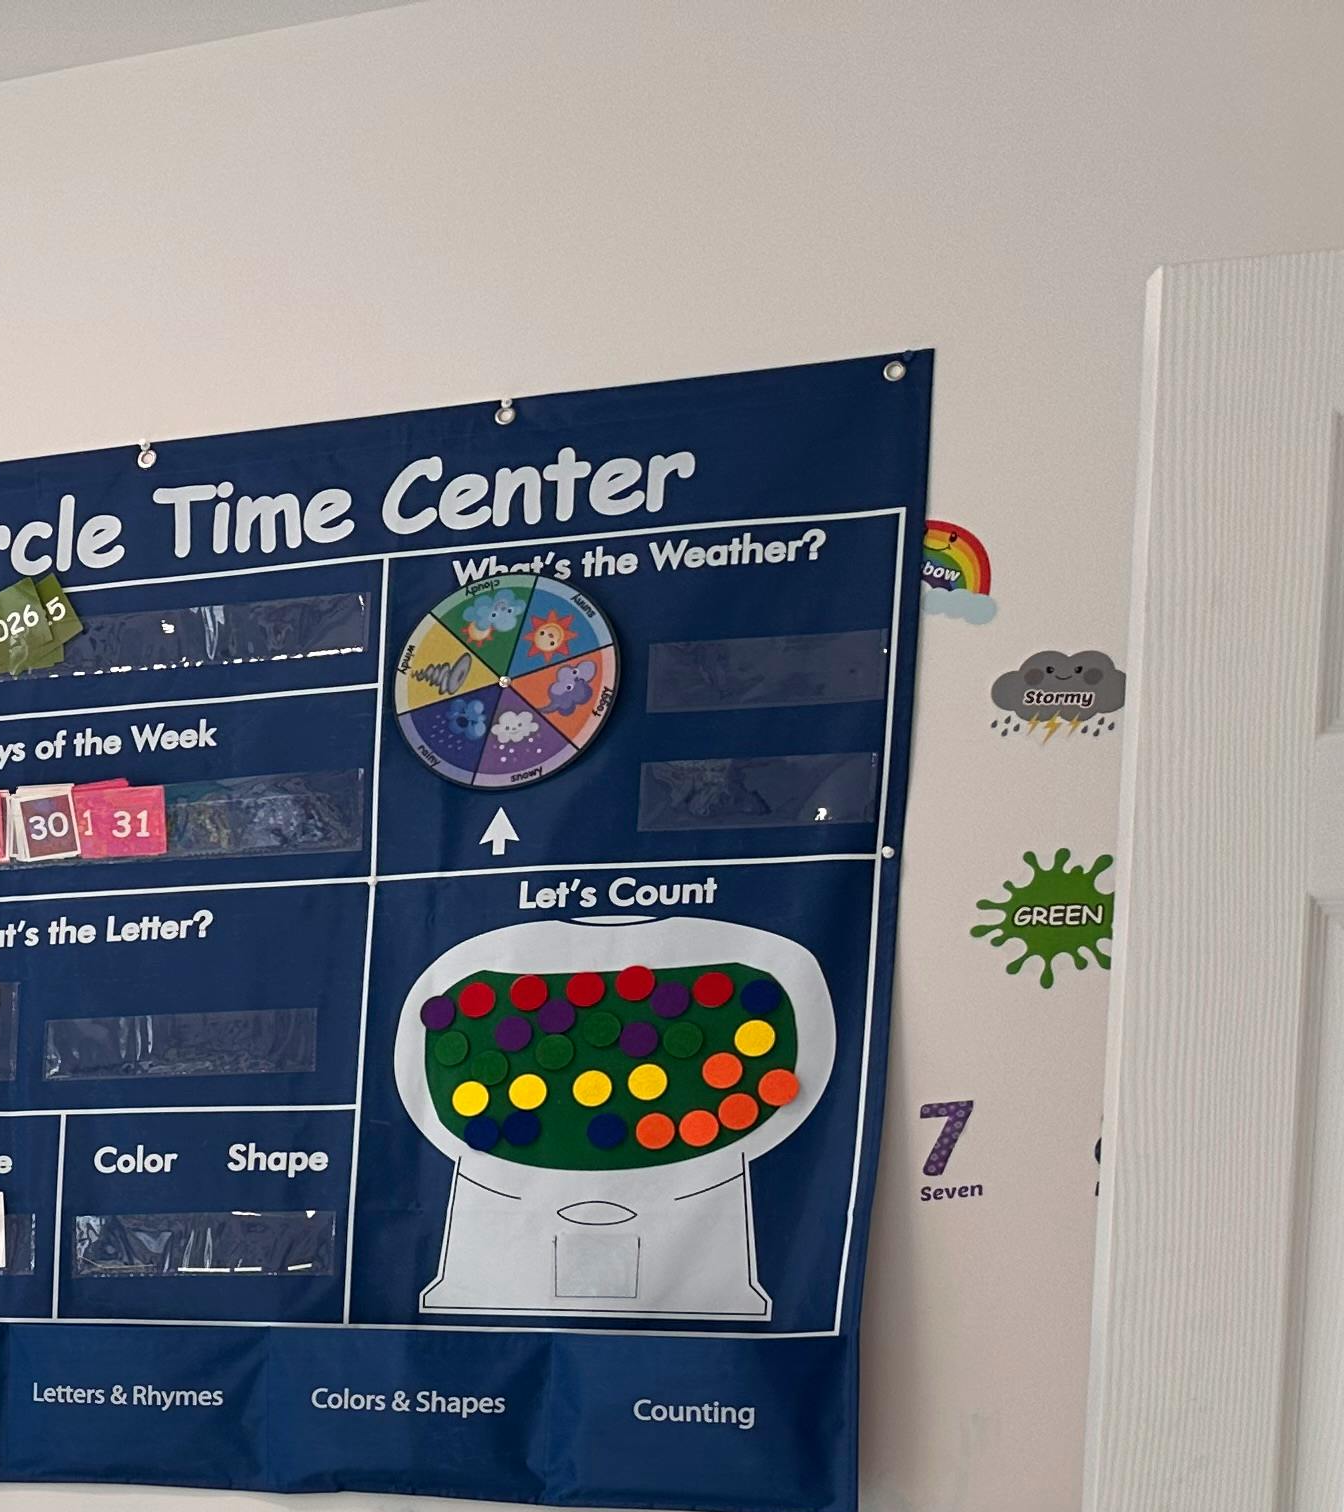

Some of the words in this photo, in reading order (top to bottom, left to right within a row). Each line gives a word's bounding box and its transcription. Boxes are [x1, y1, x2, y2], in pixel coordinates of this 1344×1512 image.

[152, 480, 356, 559] Time
[381, 446, 696, 535] Center
[581, 546, 638, 578] the
[648, 528, 826, 572] Weather?
[465, 580, 501, 596] cloudy
[570, 592, 596, 619] sunny
[398, 644, 416, 676] windy
[592, 686, 615, 718] foggy
[1023, 689, 1095, 709] Stormy
[35, 729, 66, 760] of
[73, 728, 122, 756] the
[130, 719, 218, 752] Week
[510, 766, 543, 783] snowy
[28, 811, 69, 842] 30
[111, 809, 150, 839] 31
[518, 878, 597, 910] Let's
[608, 876, 718, 908] Count
[47, 911, 96, 944] the
[105, 909, 214, 943] Letter?
[1012, 904, 1104, 927] GREEN
[920, 1100, 974, 1177] 7
[93, 1144, 179, 1175] Color
[227, 1142, 330, 1179] Shape
[920, 1183, 984, 1202] Seven
[32, 1381, 105, 1406] Letters
[110, 1384, 129, 1407] &
[132, 1385, 225, 1411] Rhymes
[311, 1387, 386, 1413] Colors
[392, 1390, 411, 1413] &
[415, 1390, 506, 1418] Shapes
[633, 1398, 756, 1430] Counting
